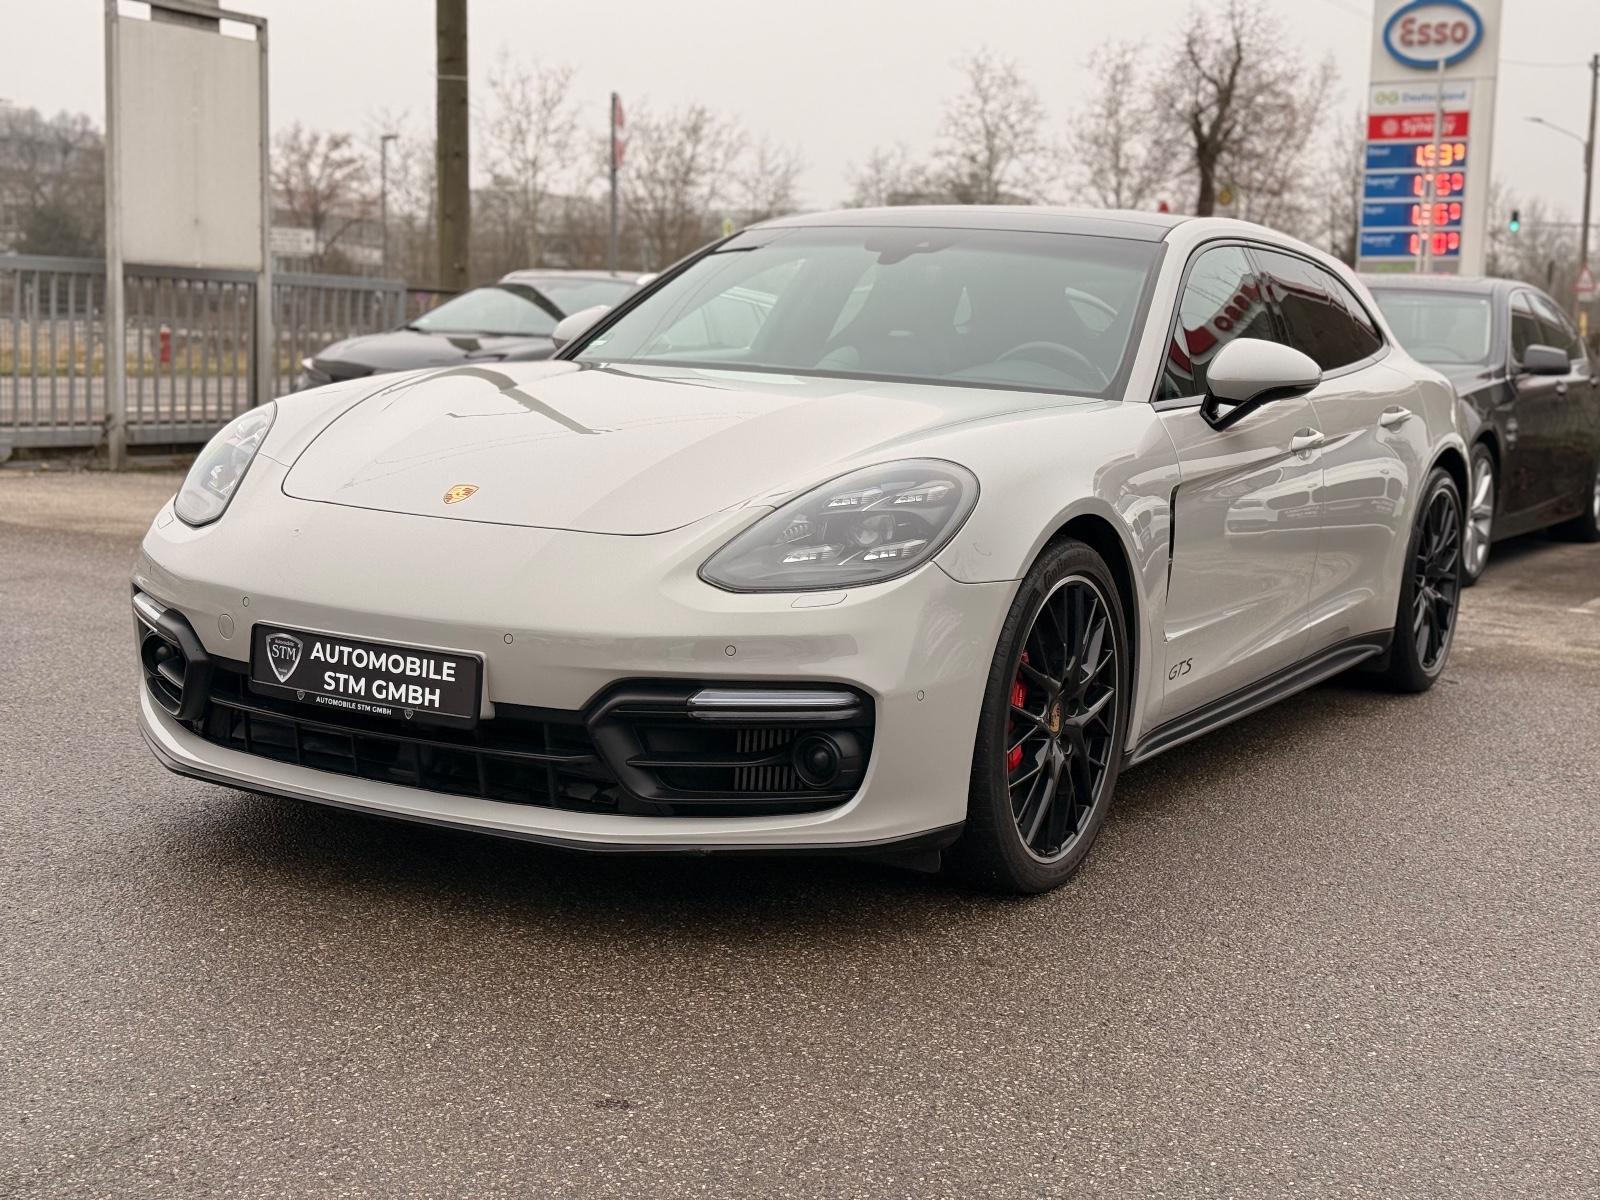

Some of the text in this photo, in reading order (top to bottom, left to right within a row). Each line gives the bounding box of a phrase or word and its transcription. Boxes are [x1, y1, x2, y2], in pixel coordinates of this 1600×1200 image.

[1400, 16, 1469, 47] Esso
[272, 644, 297, 661] STM
[310, 641, 457, 682] AUTOMOBILE
[1169, 657, 1193, 680] GTS
[323, 671, 441, 708] STM GMBH
[315, 696, 392, 716] AUTOMOBILE STM GMBH
